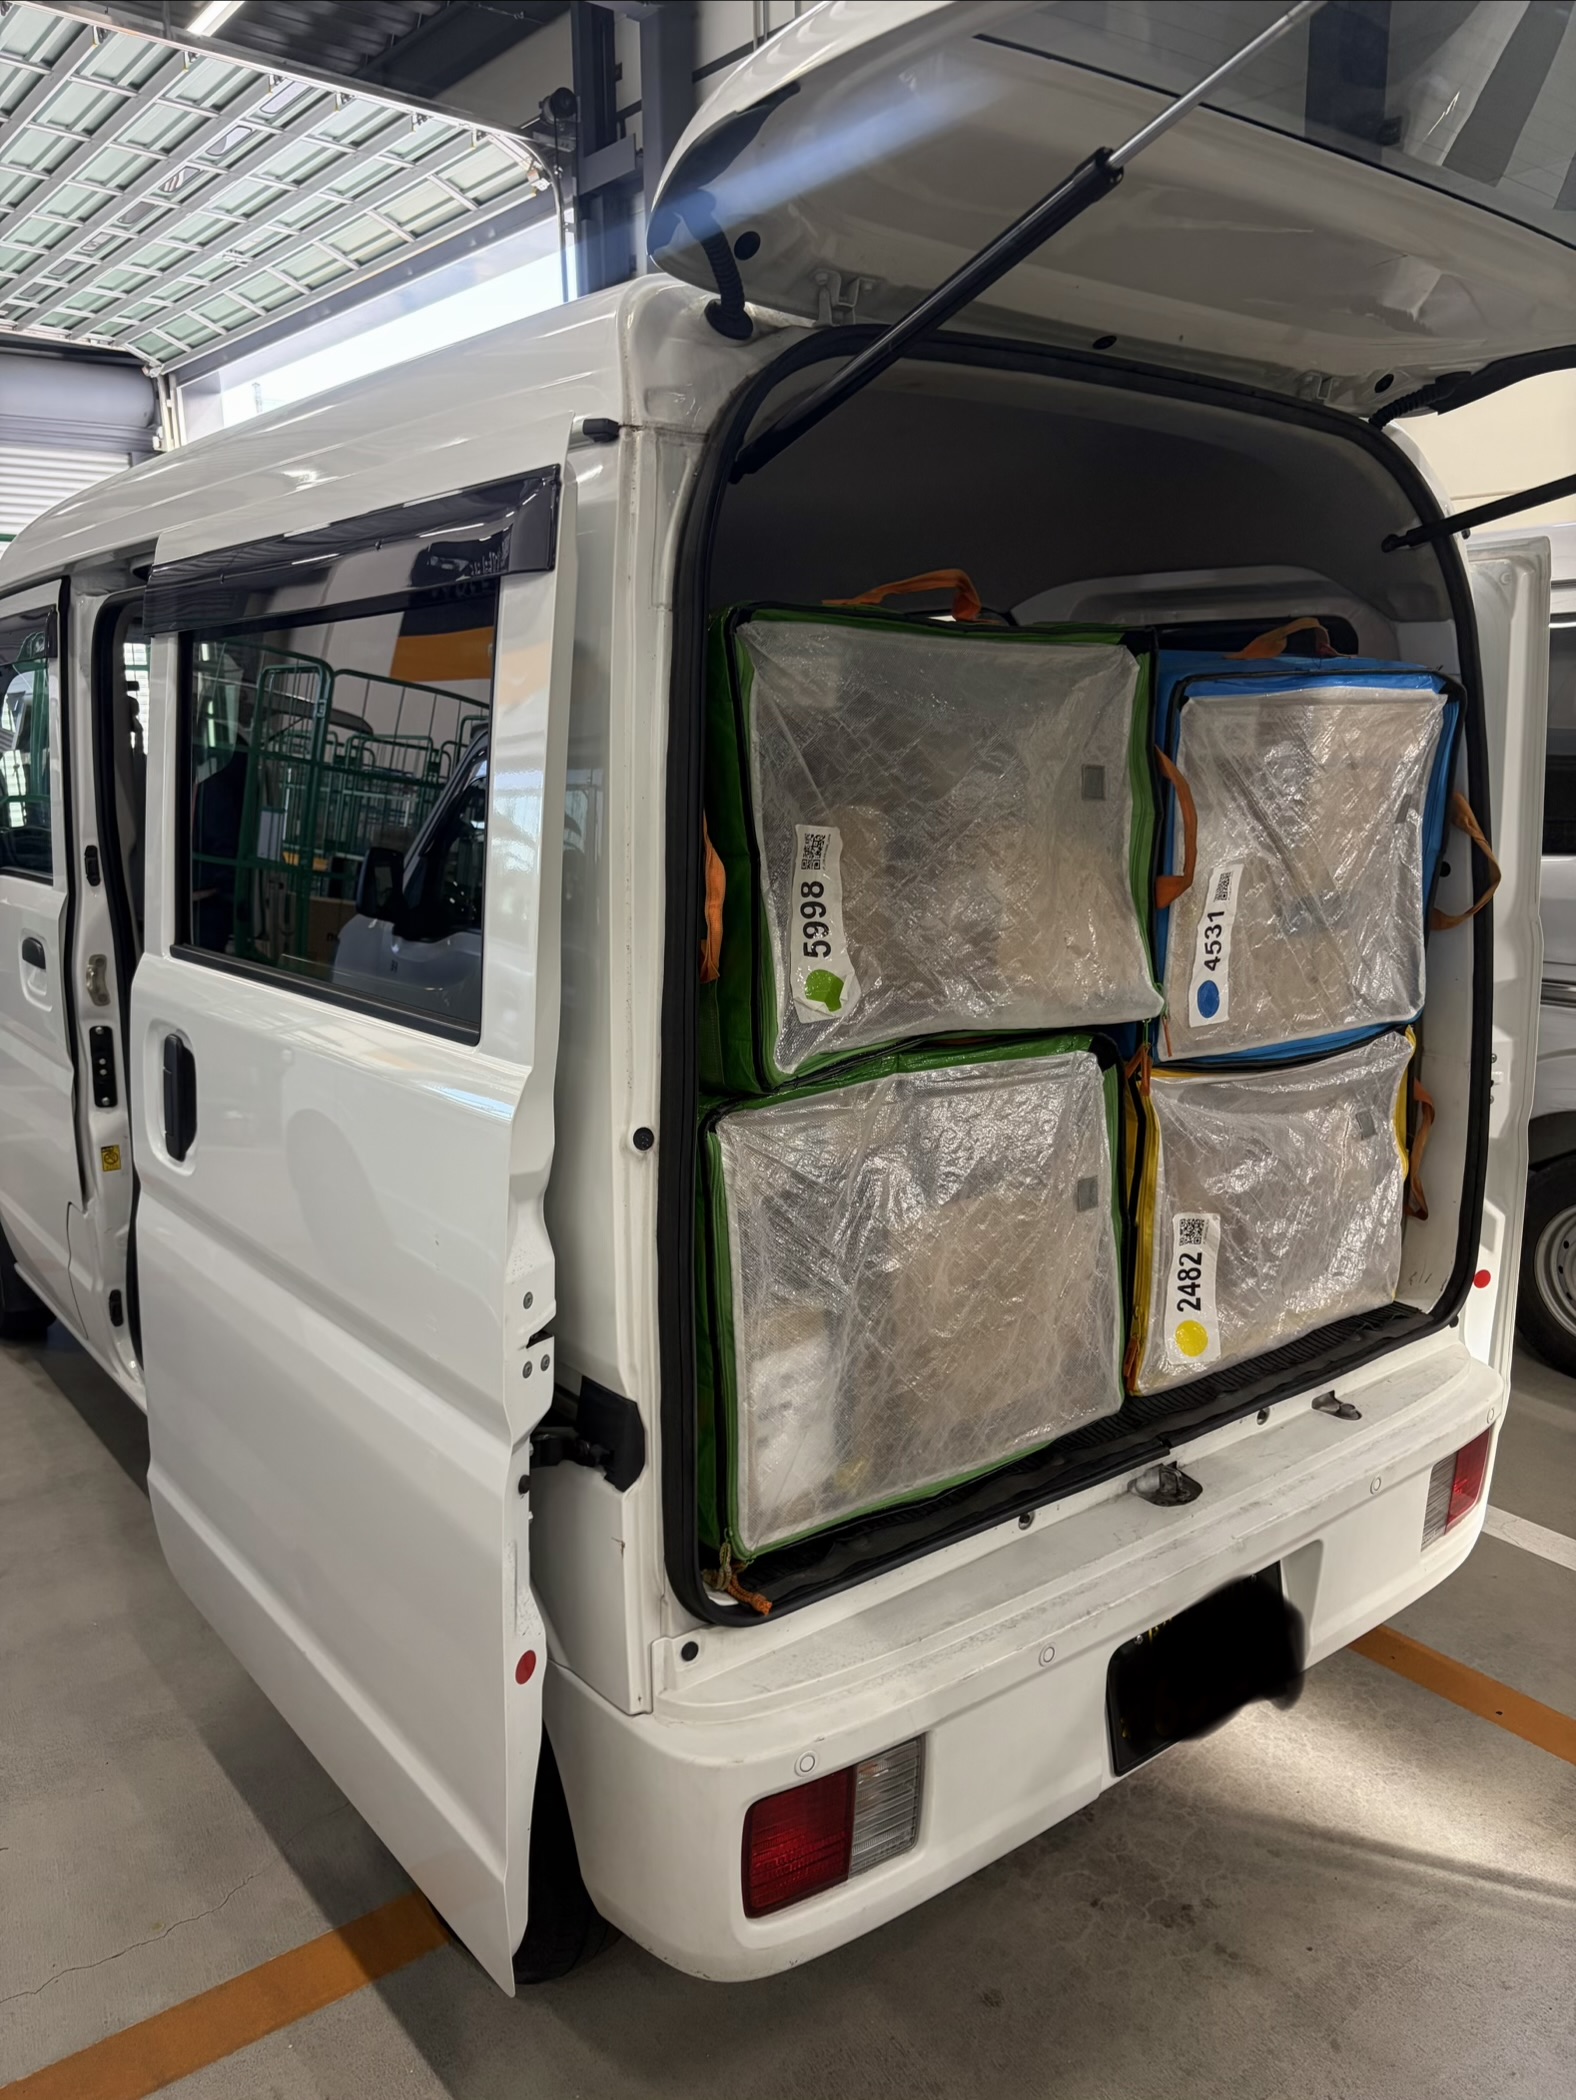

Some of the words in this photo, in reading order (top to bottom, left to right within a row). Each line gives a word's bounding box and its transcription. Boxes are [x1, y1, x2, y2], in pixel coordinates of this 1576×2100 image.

[800, 881, 831, 958] 5998
[1204, 911, 1225, 972] 4531
[1177, 1252, 1202, 1312] 2482
